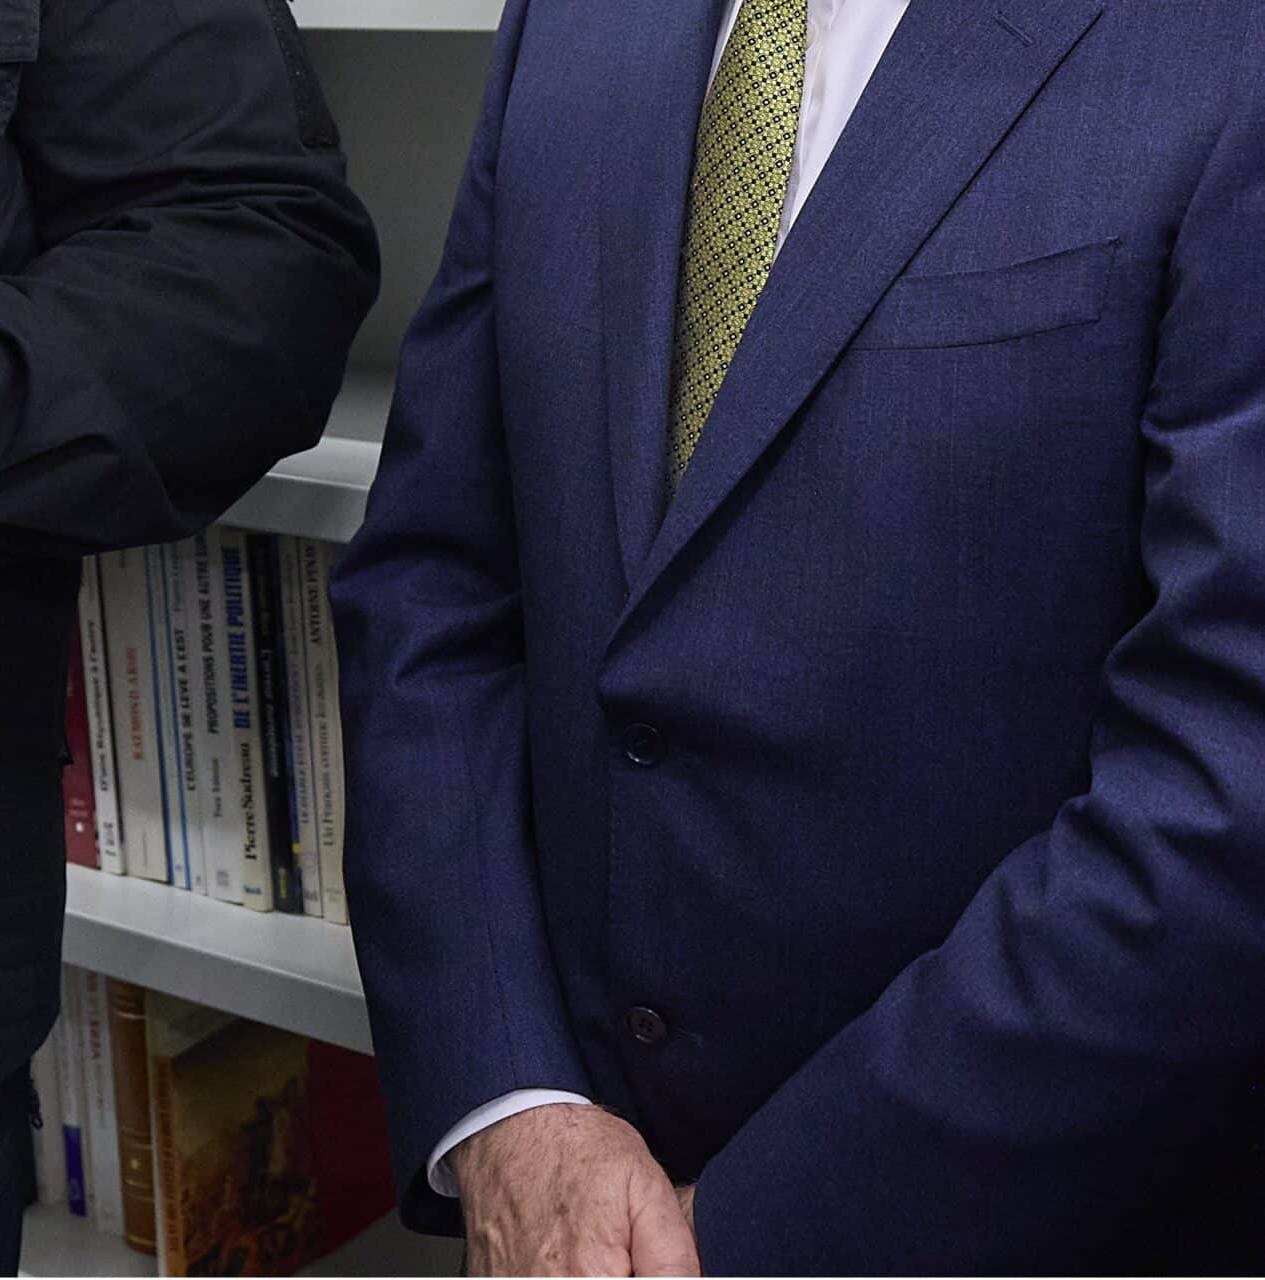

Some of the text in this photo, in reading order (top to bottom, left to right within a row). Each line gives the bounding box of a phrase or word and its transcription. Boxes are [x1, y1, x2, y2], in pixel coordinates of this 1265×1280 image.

[198, 599, 211, 620] UNE
[199, 623, 212, 653] POUR
[224, 547, 251, 729] DE L'INERTIE POLITIQUE
[202, 656, 218, 735] PROPOSITIONS
[181, 713, 190, 728] SE
[243, 813, 256, 861] Pierre
